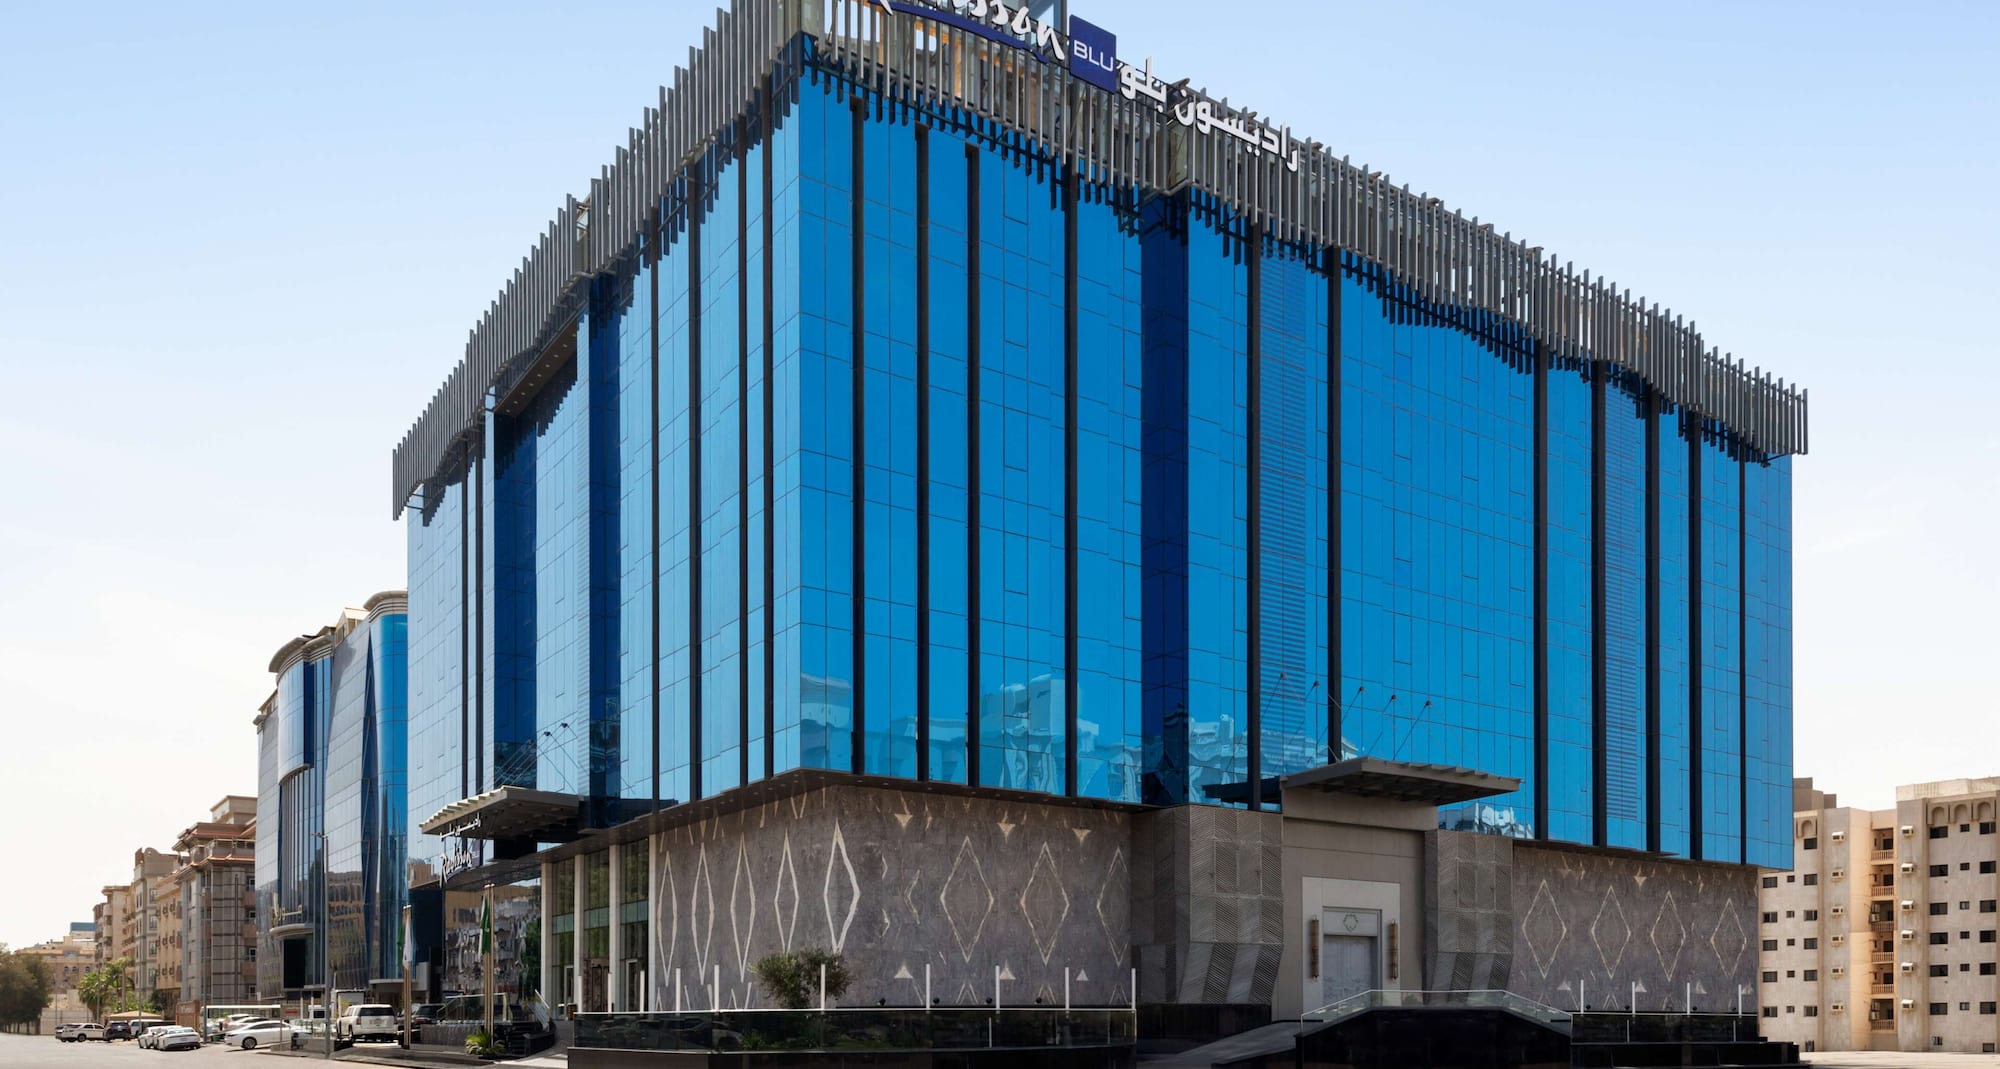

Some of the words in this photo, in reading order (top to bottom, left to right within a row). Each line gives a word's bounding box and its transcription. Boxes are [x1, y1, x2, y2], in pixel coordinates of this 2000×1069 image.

[1074, 40, 1113, 72] BLU
[1119, 56, 1167, 113] بلو
[1174, 88, 1298, 172] راديسون
